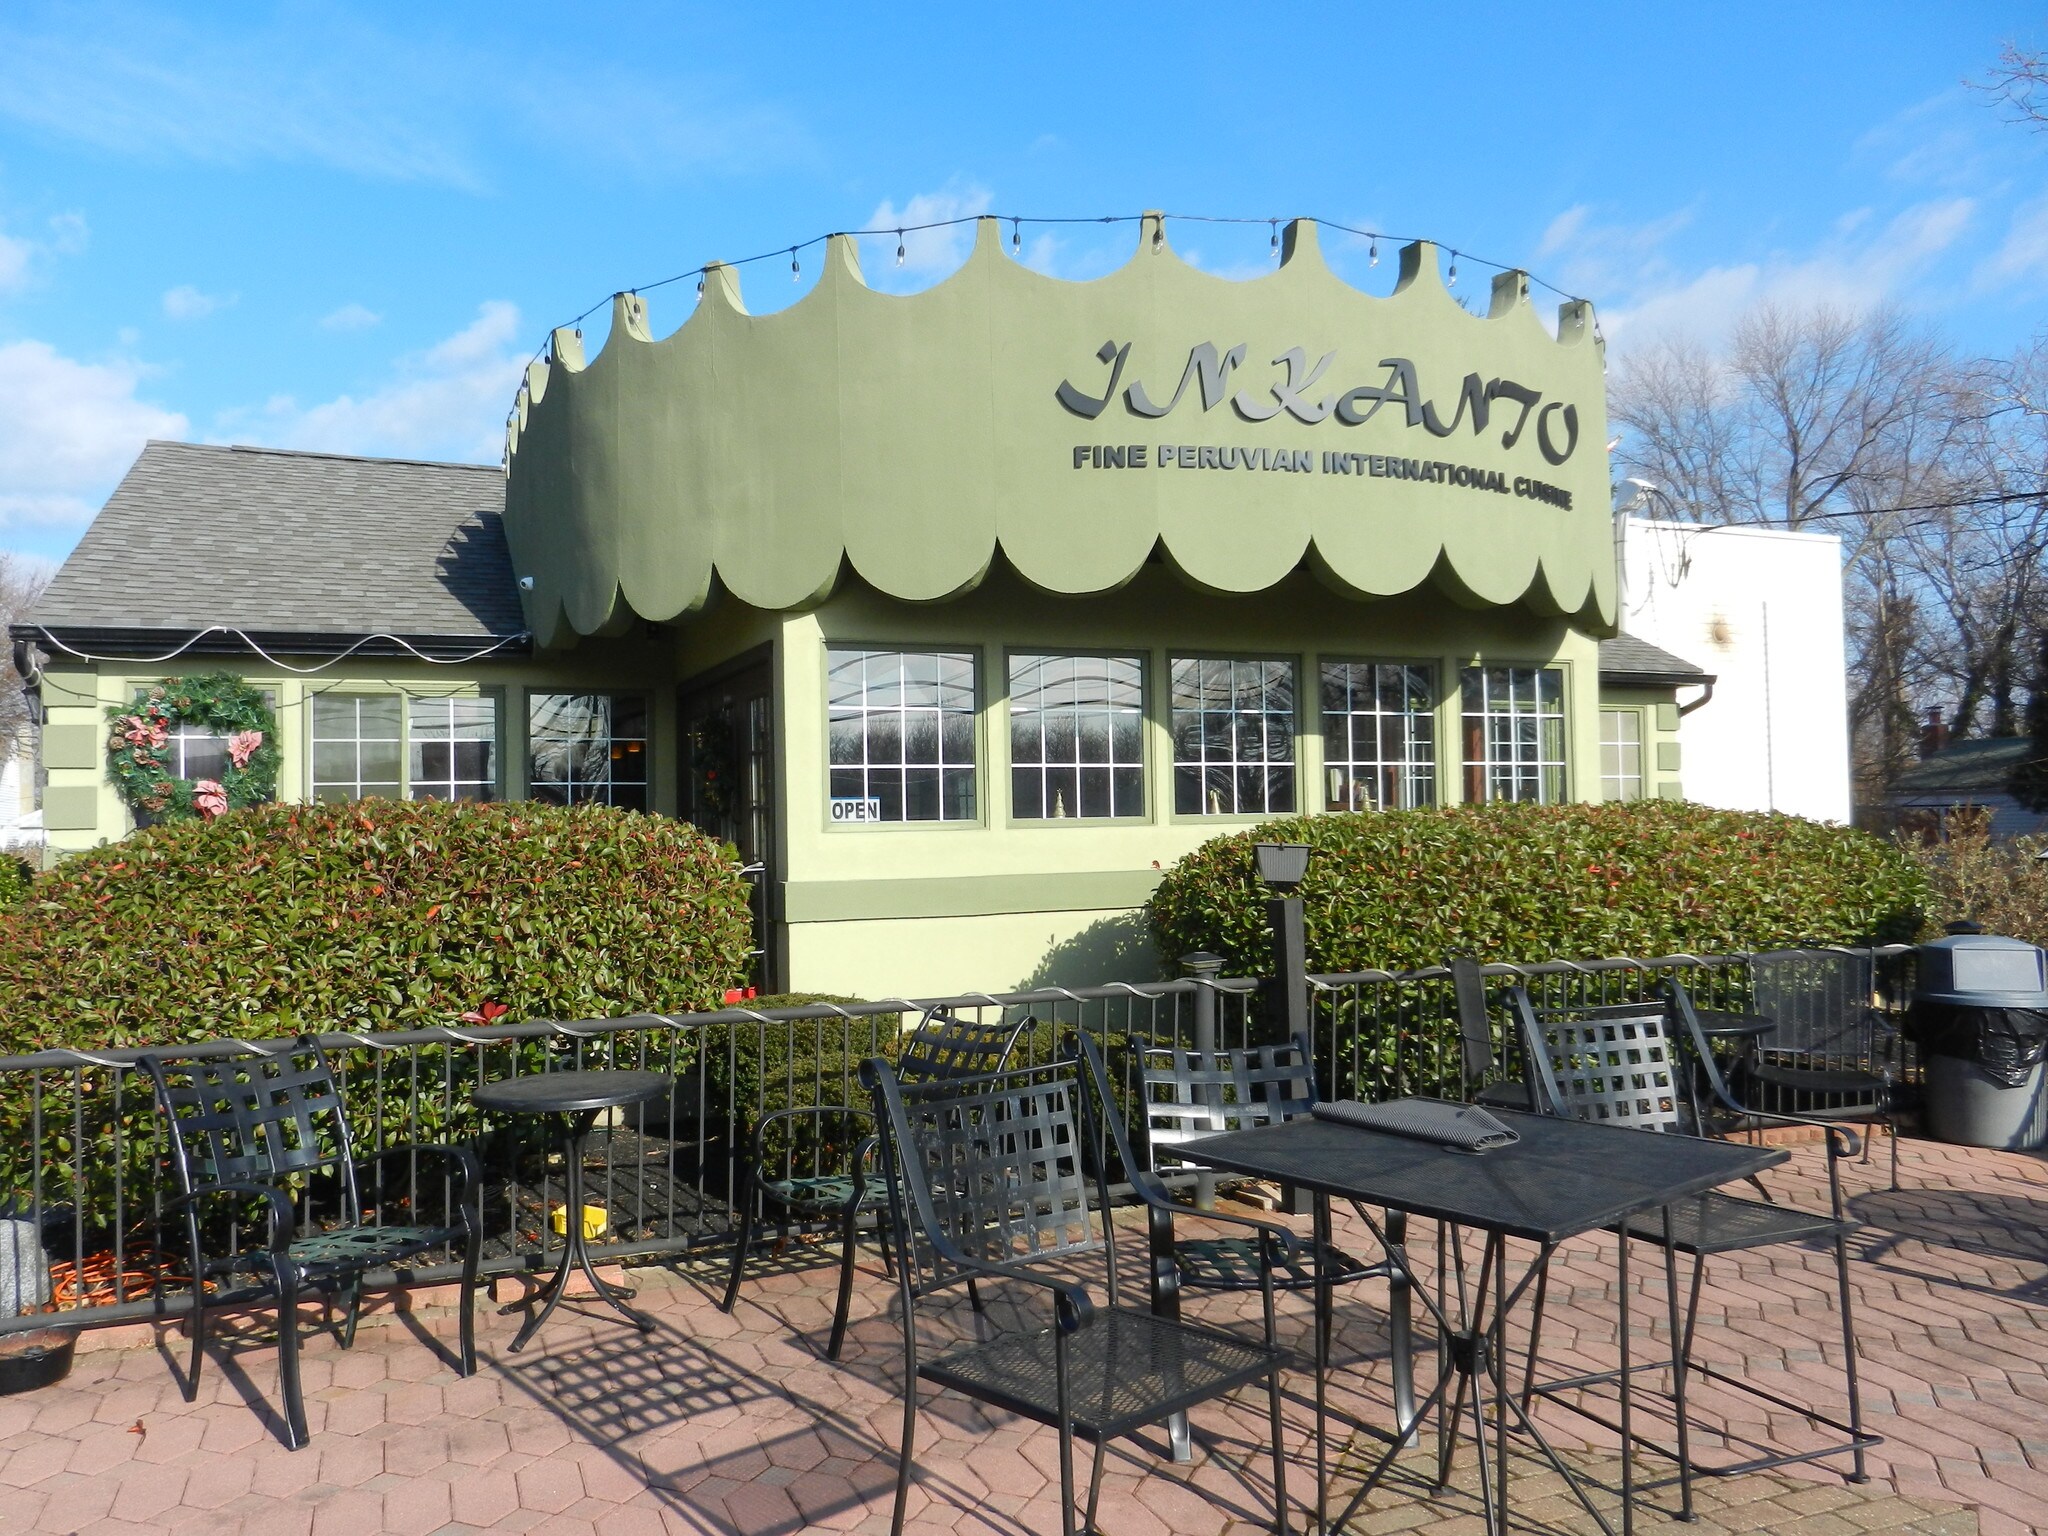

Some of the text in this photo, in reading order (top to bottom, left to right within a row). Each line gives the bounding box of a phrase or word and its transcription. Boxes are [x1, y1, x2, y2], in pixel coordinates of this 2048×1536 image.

[1054, 339, 1579, 466] INKANTO
[1073, 445, 1148, 469] FINE
[1158, 445, 1313, 473] PERUVIAN
[1322, 451, 1511, 494] INTERNATIONAL
[832, 802, 878, 819] OPEN
